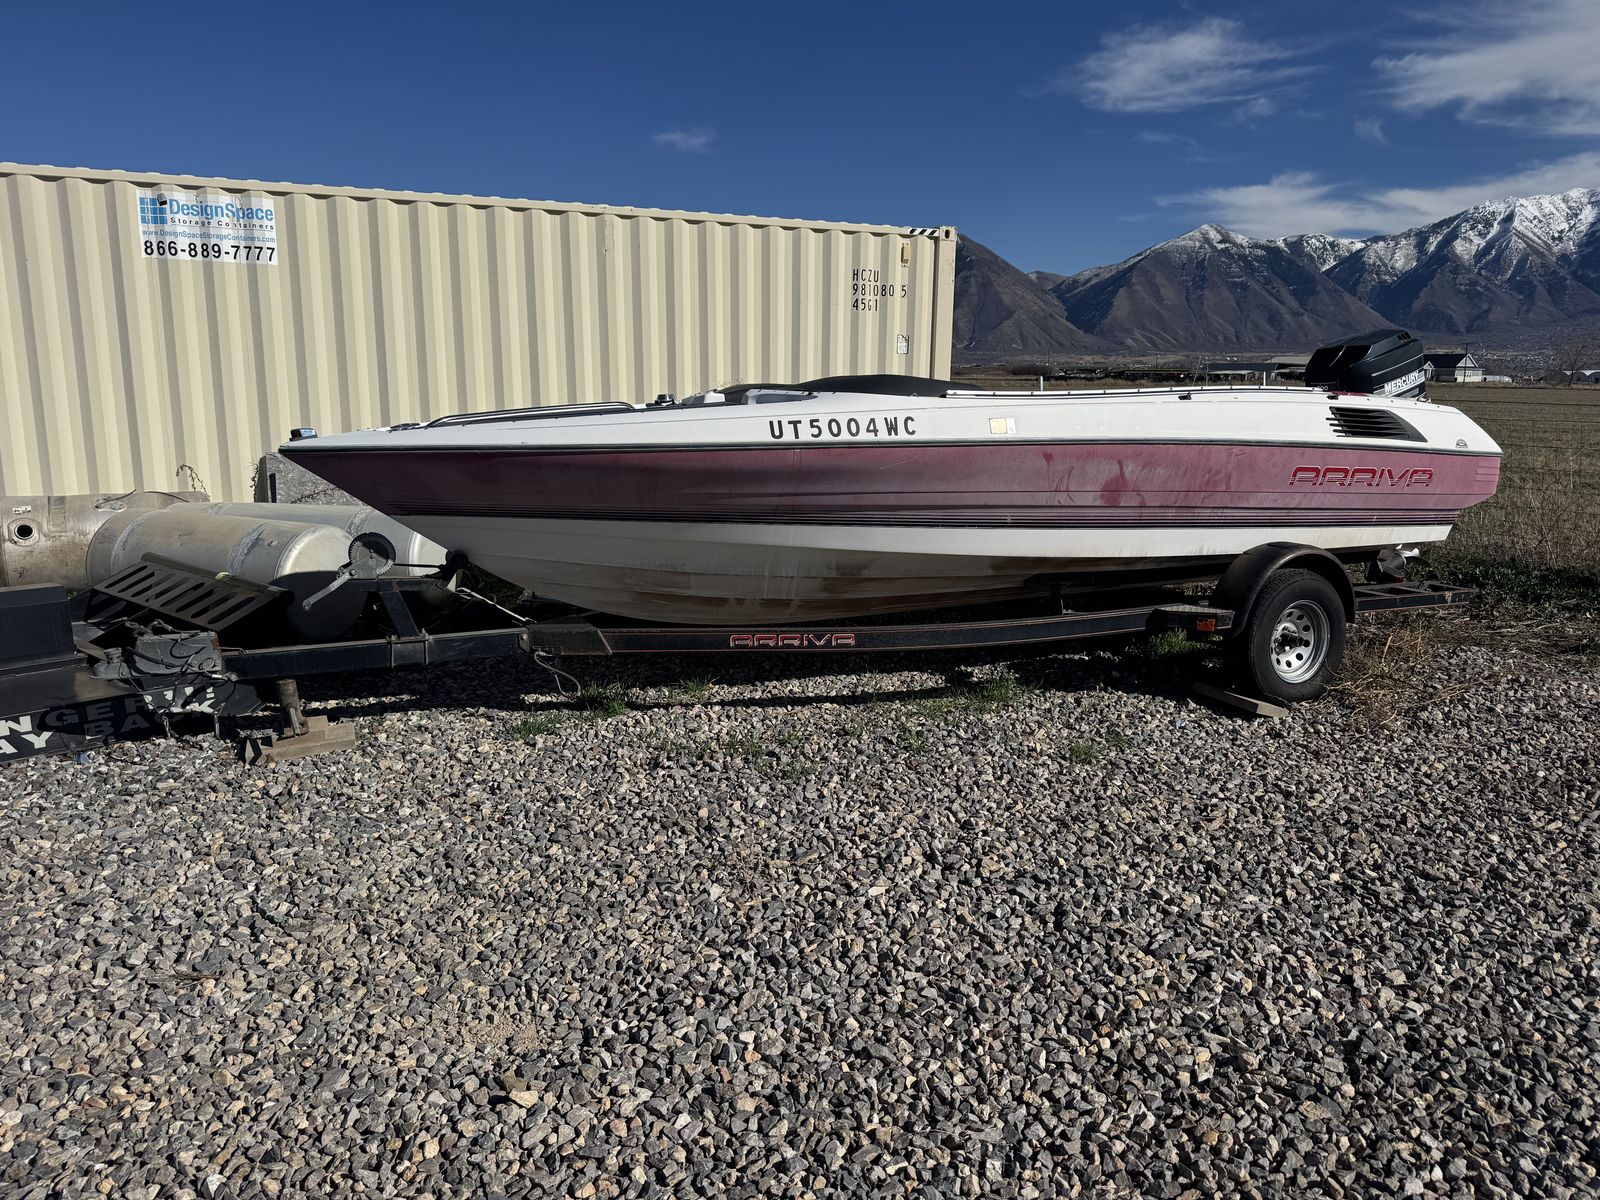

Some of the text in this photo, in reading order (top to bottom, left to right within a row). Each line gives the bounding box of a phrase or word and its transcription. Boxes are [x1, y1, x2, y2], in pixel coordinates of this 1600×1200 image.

[169, 198, 274, 221] DesignSpace
[171, 217, 275, 231] Storage Containers
[142, 229, 275, 243] www.DesignSpaceStorageContainers.com
[144, 240, 276, 262] 866-889-7777
[852, 268, 879, 283] HCZU
[852, 283, 907, 298] 981080 5
[852, 298, 878, 311] 45G1
[1384, 370, 1419, 394] MERCURY
[1288, 465, 1434, 488] ARRIVA
[729, 633, 856, 647] ARRIVA
